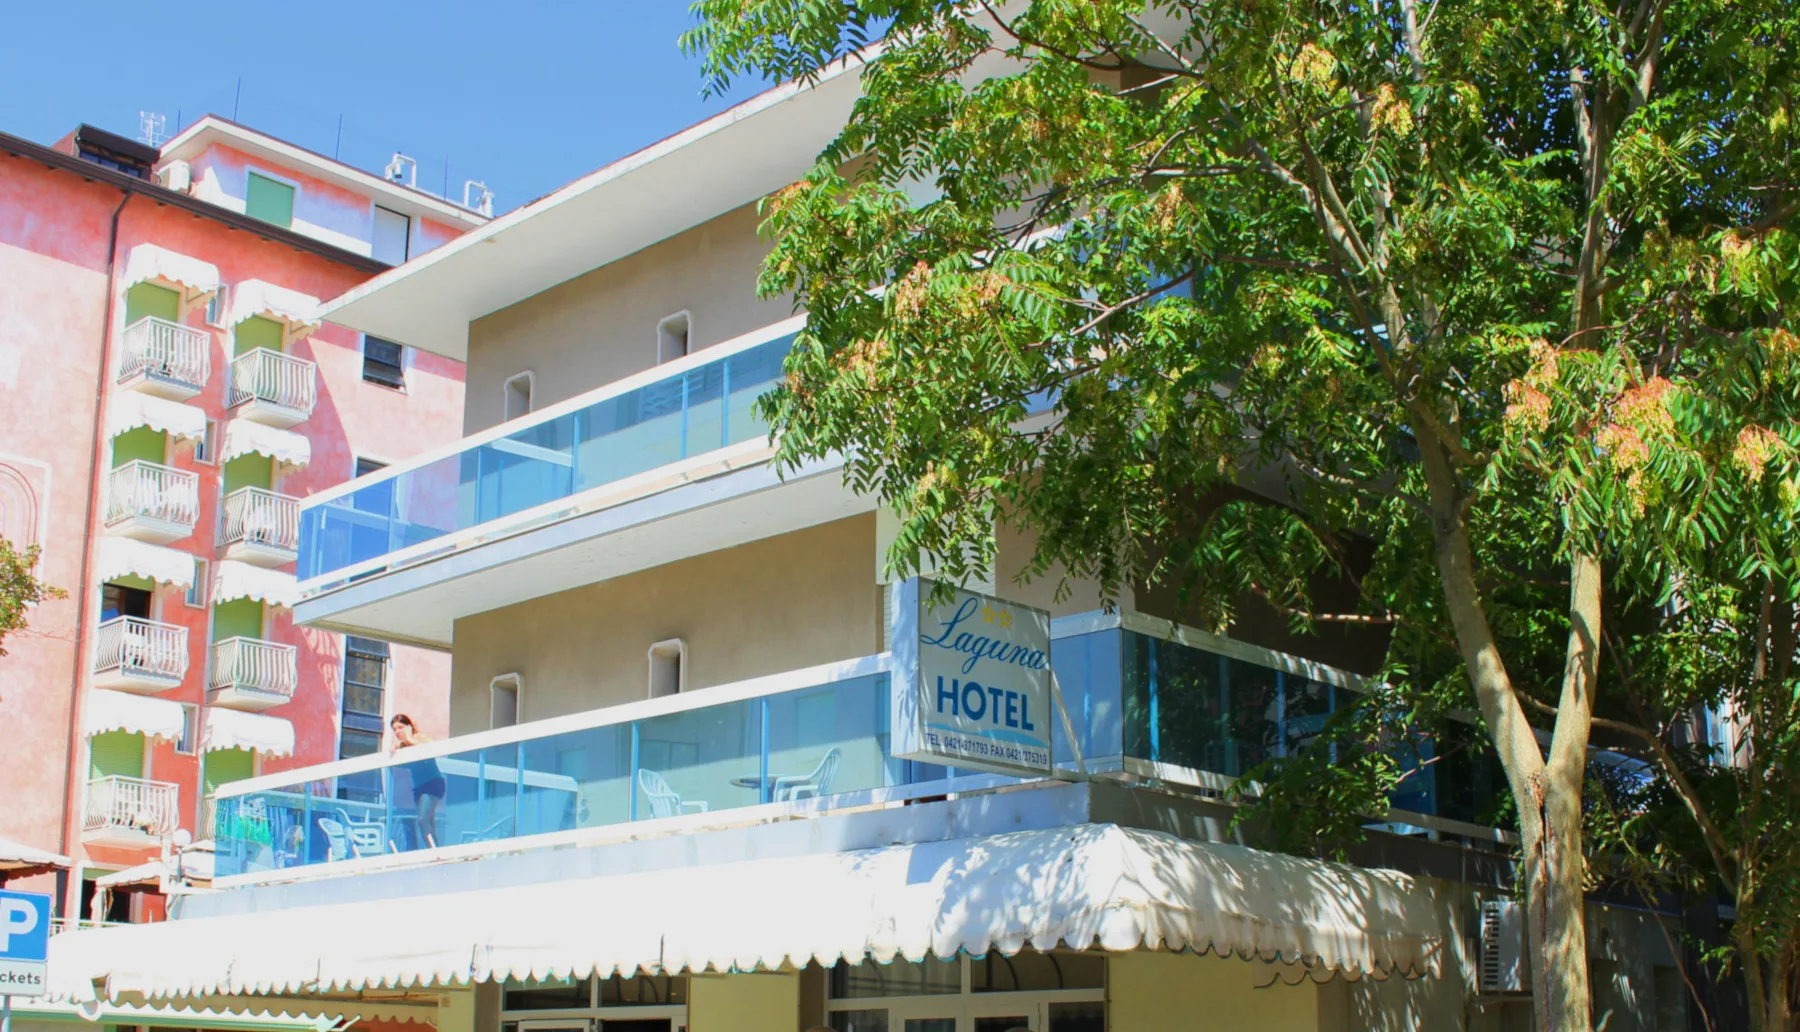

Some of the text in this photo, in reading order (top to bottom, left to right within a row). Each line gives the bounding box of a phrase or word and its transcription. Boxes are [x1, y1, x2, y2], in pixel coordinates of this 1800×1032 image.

[920, 597, 1048, 674] Laguna
[937, 675, 1034, 731] HOTEL
[990, 745, 1005, 758] FAX
[0, 897, 38, 952] P
